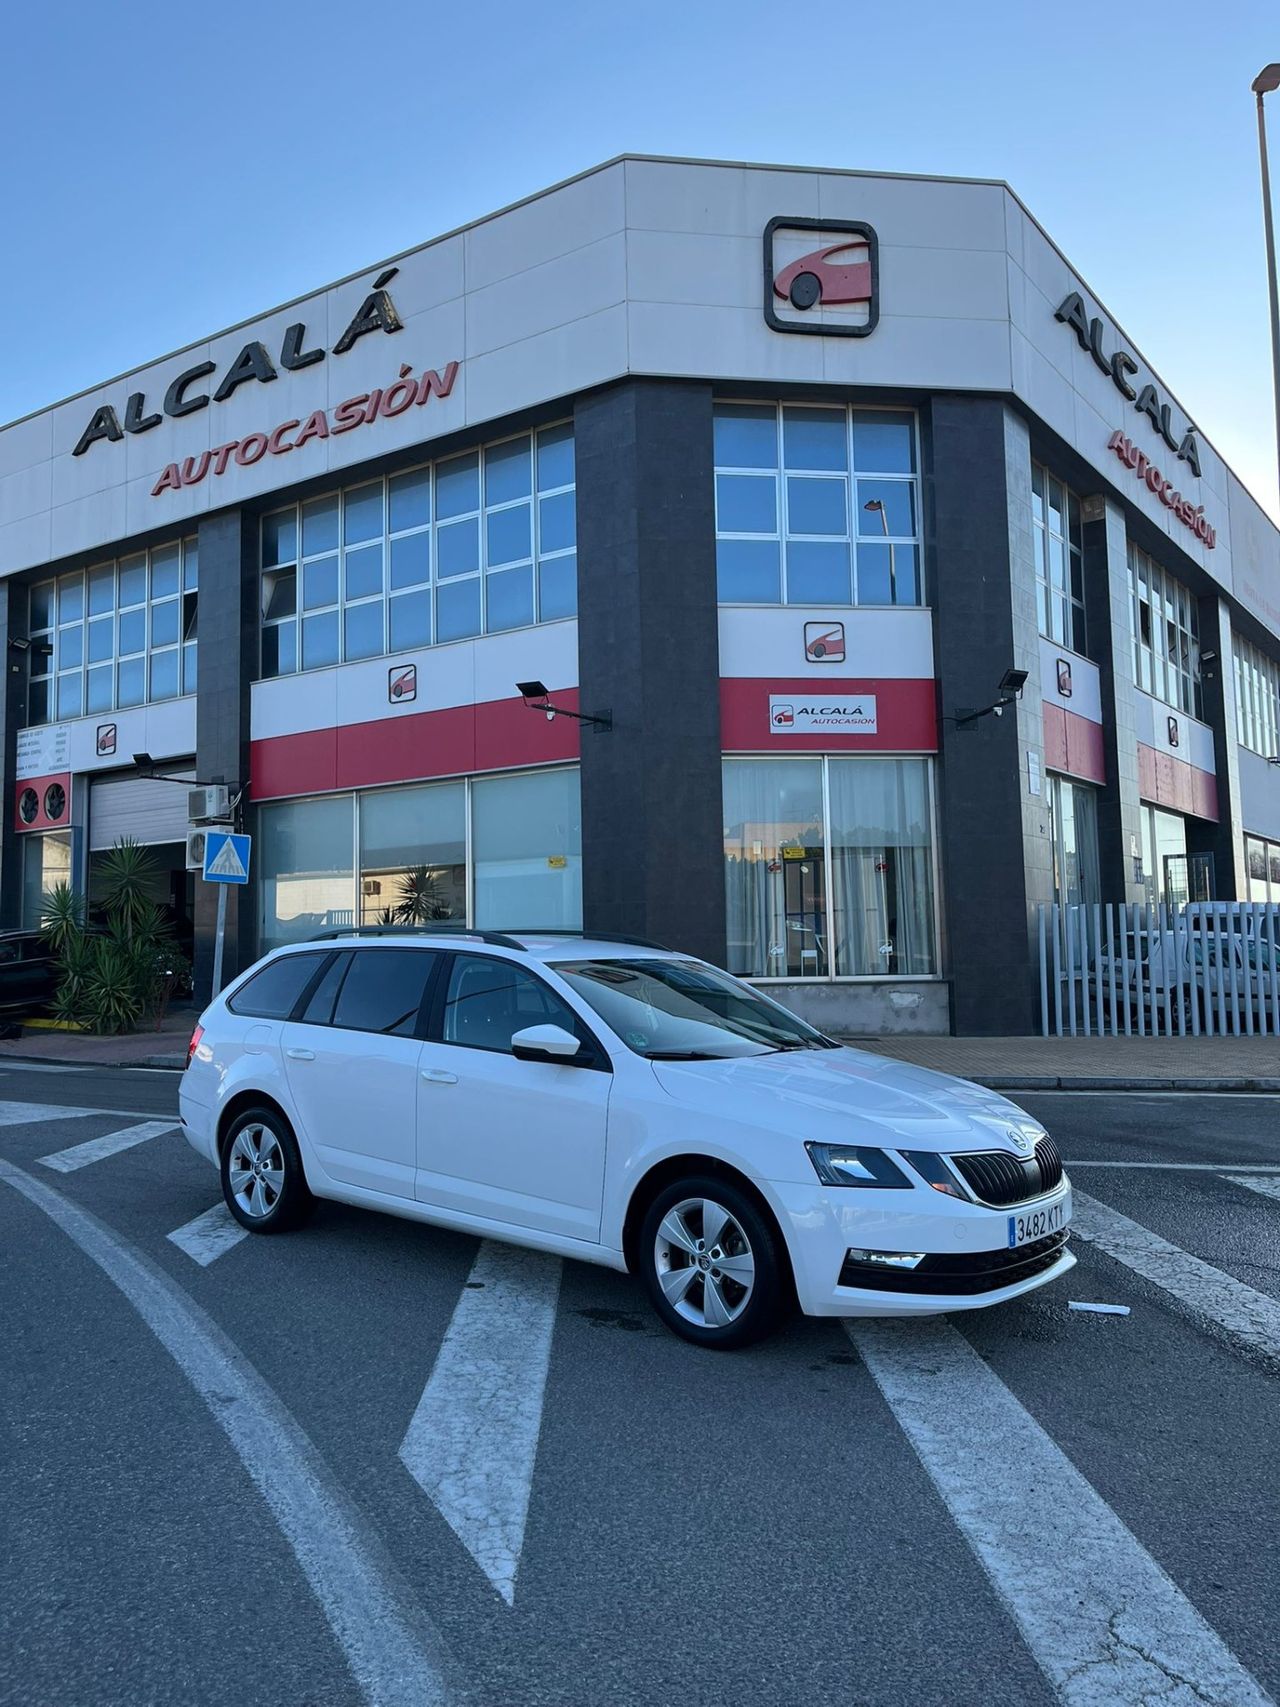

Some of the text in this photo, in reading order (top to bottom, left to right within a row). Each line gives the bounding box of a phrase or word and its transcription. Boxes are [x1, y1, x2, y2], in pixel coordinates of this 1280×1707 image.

[73, 267, 404, 456] ALCALÁ
[1054, 291, 1202, 477] ALCALÁ
[151, 361, 460, 496] AUTOCASIÓN
[1107, 430, 1216, 549] AUTOCASIÓN
[797, 705, 863, 715] ALCALÁ
[1017, 1202, 1064, 1241] 3482 KTY
